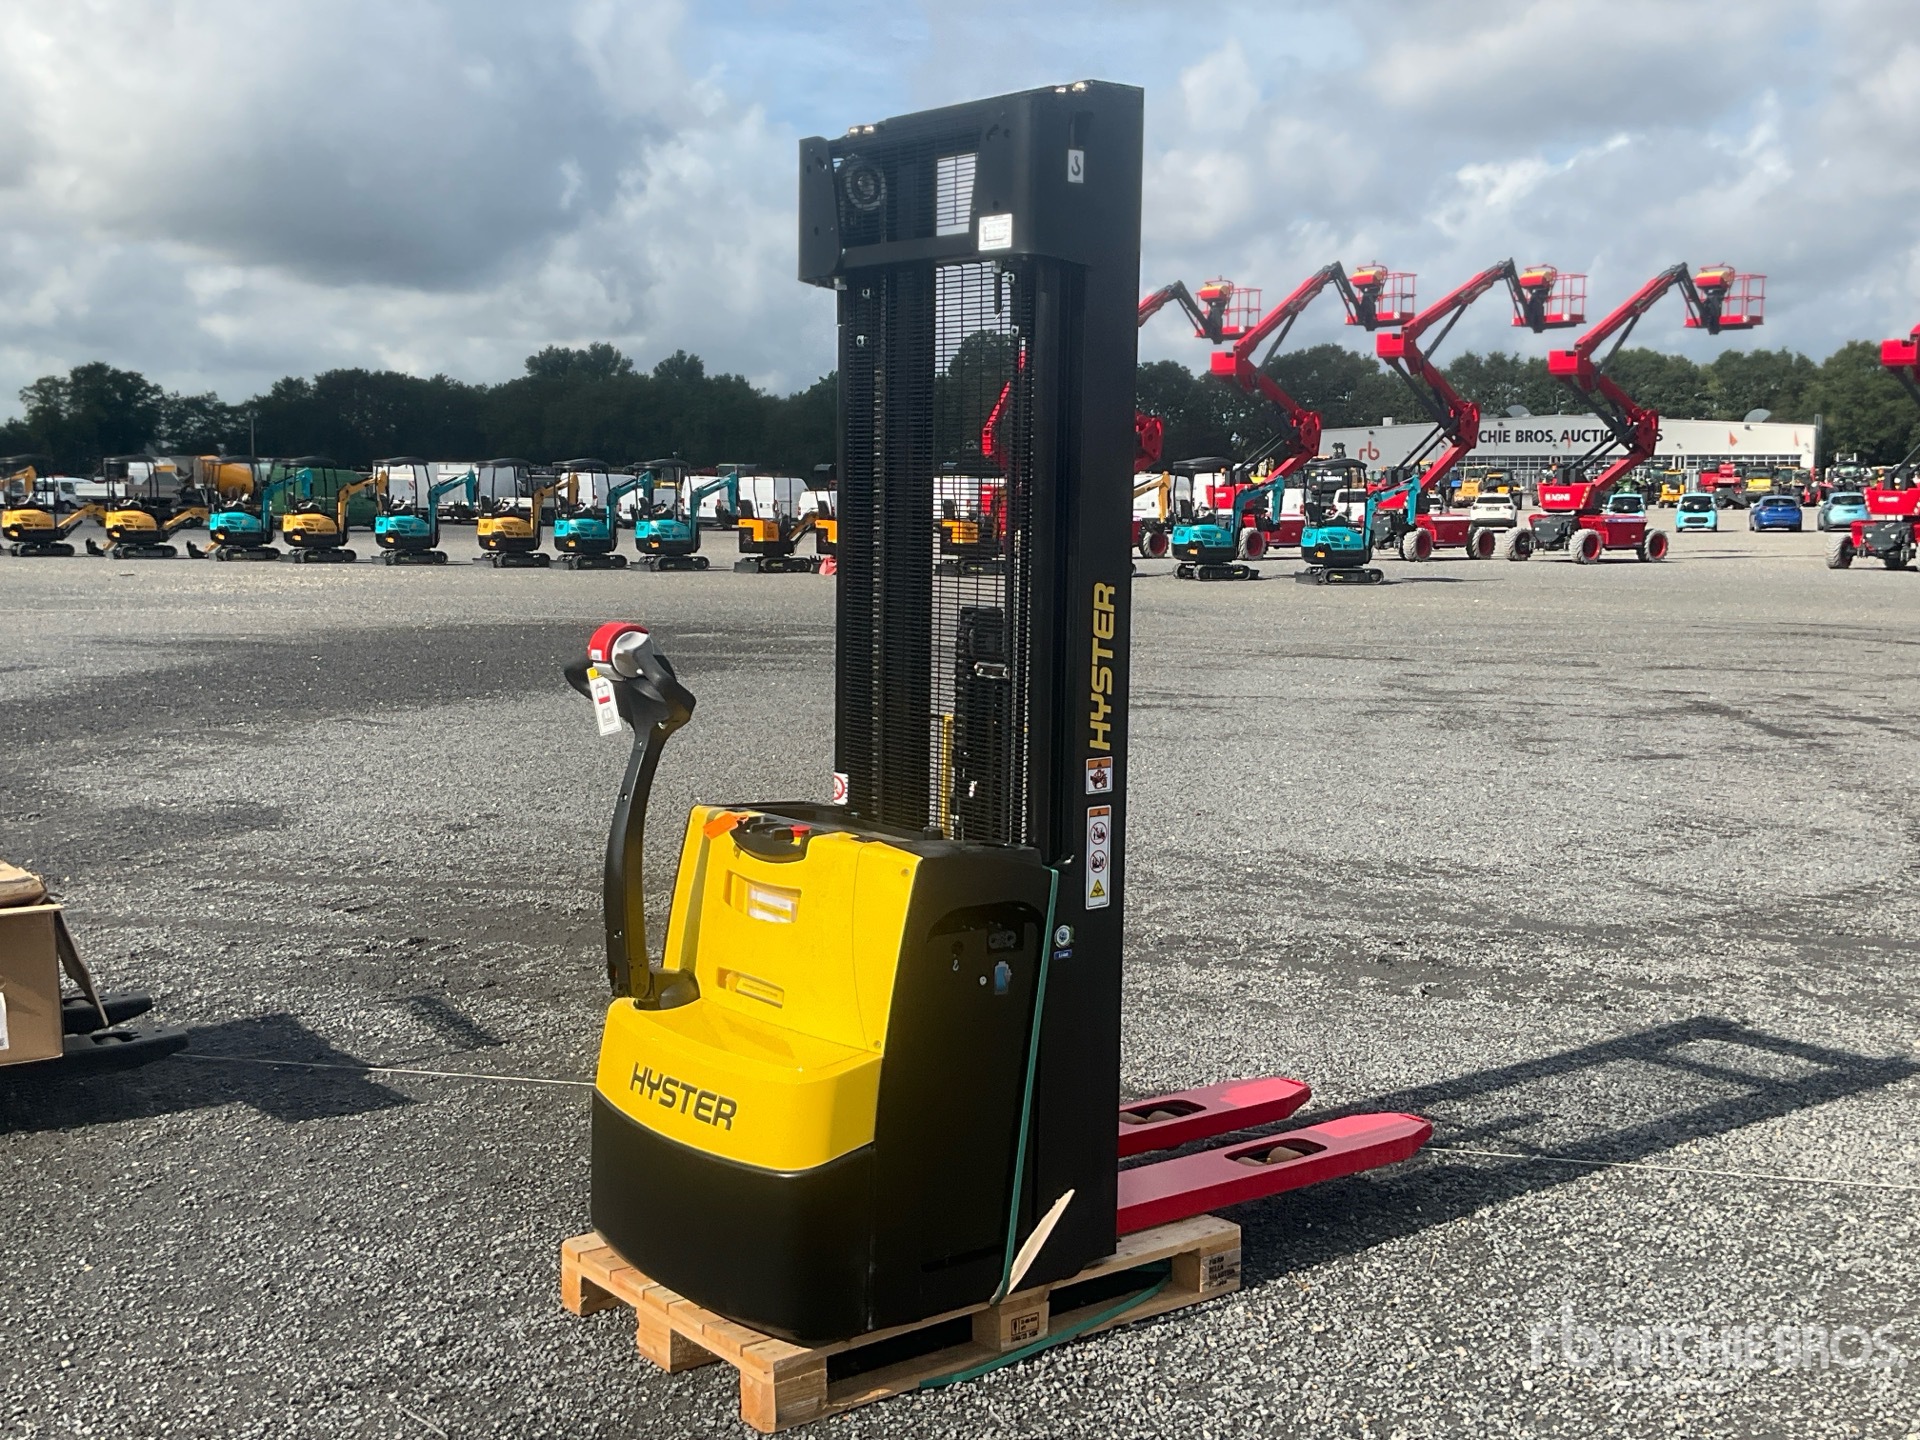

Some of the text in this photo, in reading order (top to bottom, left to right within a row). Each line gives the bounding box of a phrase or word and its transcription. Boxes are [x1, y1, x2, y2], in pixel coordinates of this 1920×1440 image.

[1358, 440, 1380, 461] rb
[1478, 430, 1511, 443] CHIE
[1515, 430, 1557, 443] BROS.
[1089, 582, 1116, 751] HYSTER
[629, 1061, 738, 1132] HYSTER
